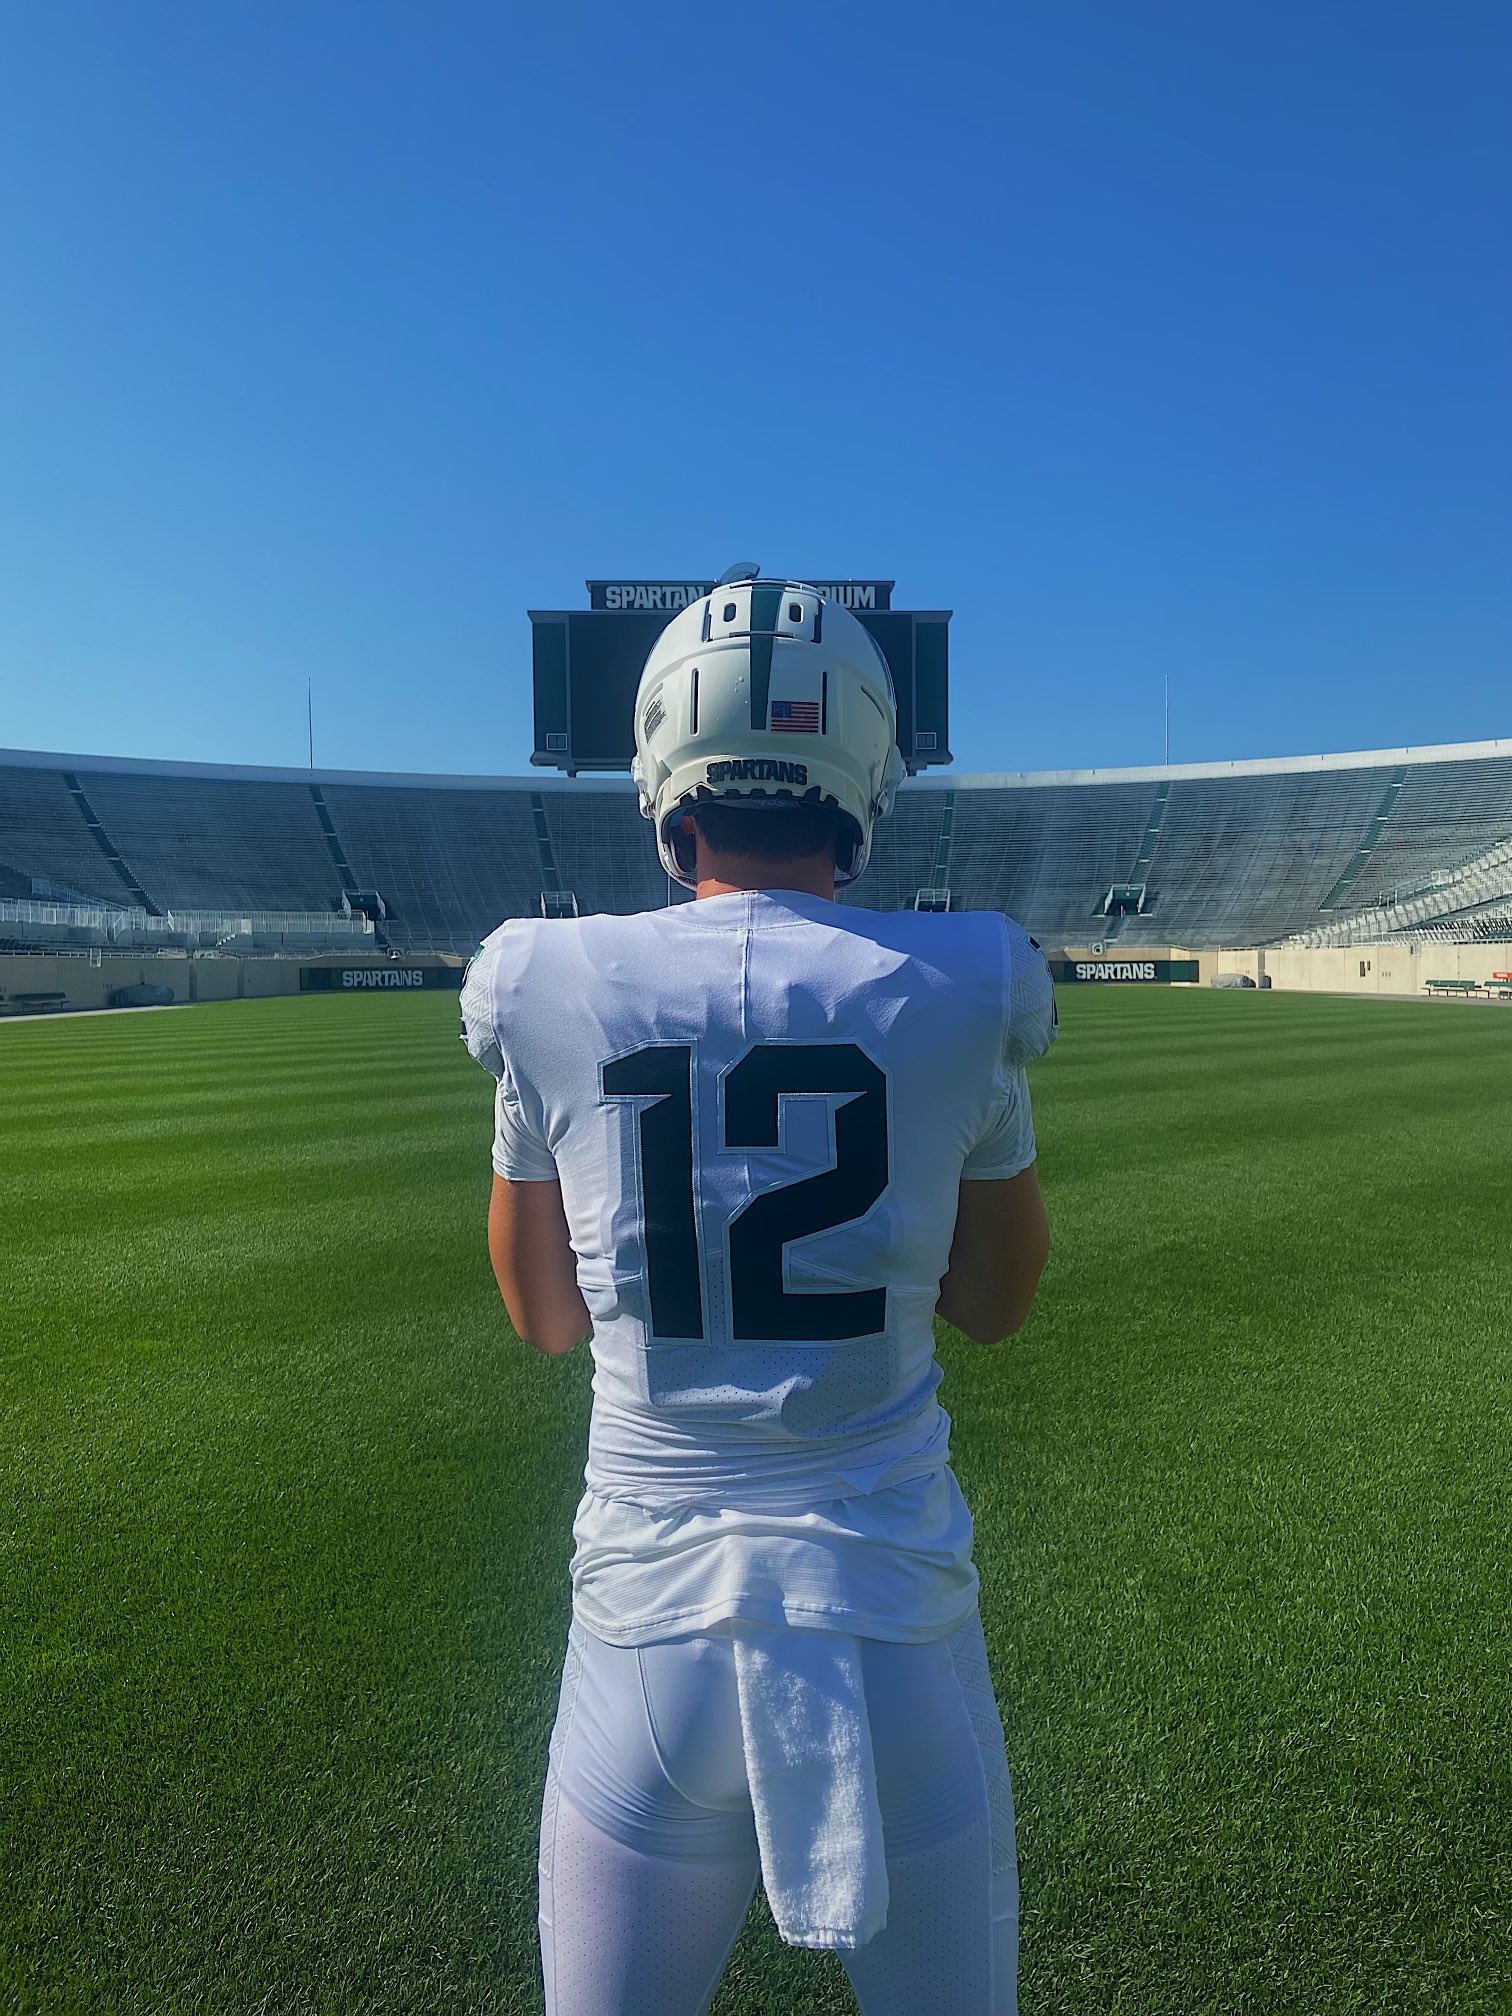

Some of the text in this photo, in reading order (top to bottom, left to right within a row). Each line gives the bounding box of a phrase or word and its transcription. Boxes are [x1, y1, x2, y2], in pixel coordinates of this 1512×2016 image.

[605, 586, 705, 609] SPARTAN
[706, 759, 808, 786] SPARTANS
[342, 969, 424, 988] SPARTANS
[1075, 962, 1156, 980] SPARTANS
[597, 1037, 895, 1346] 12
